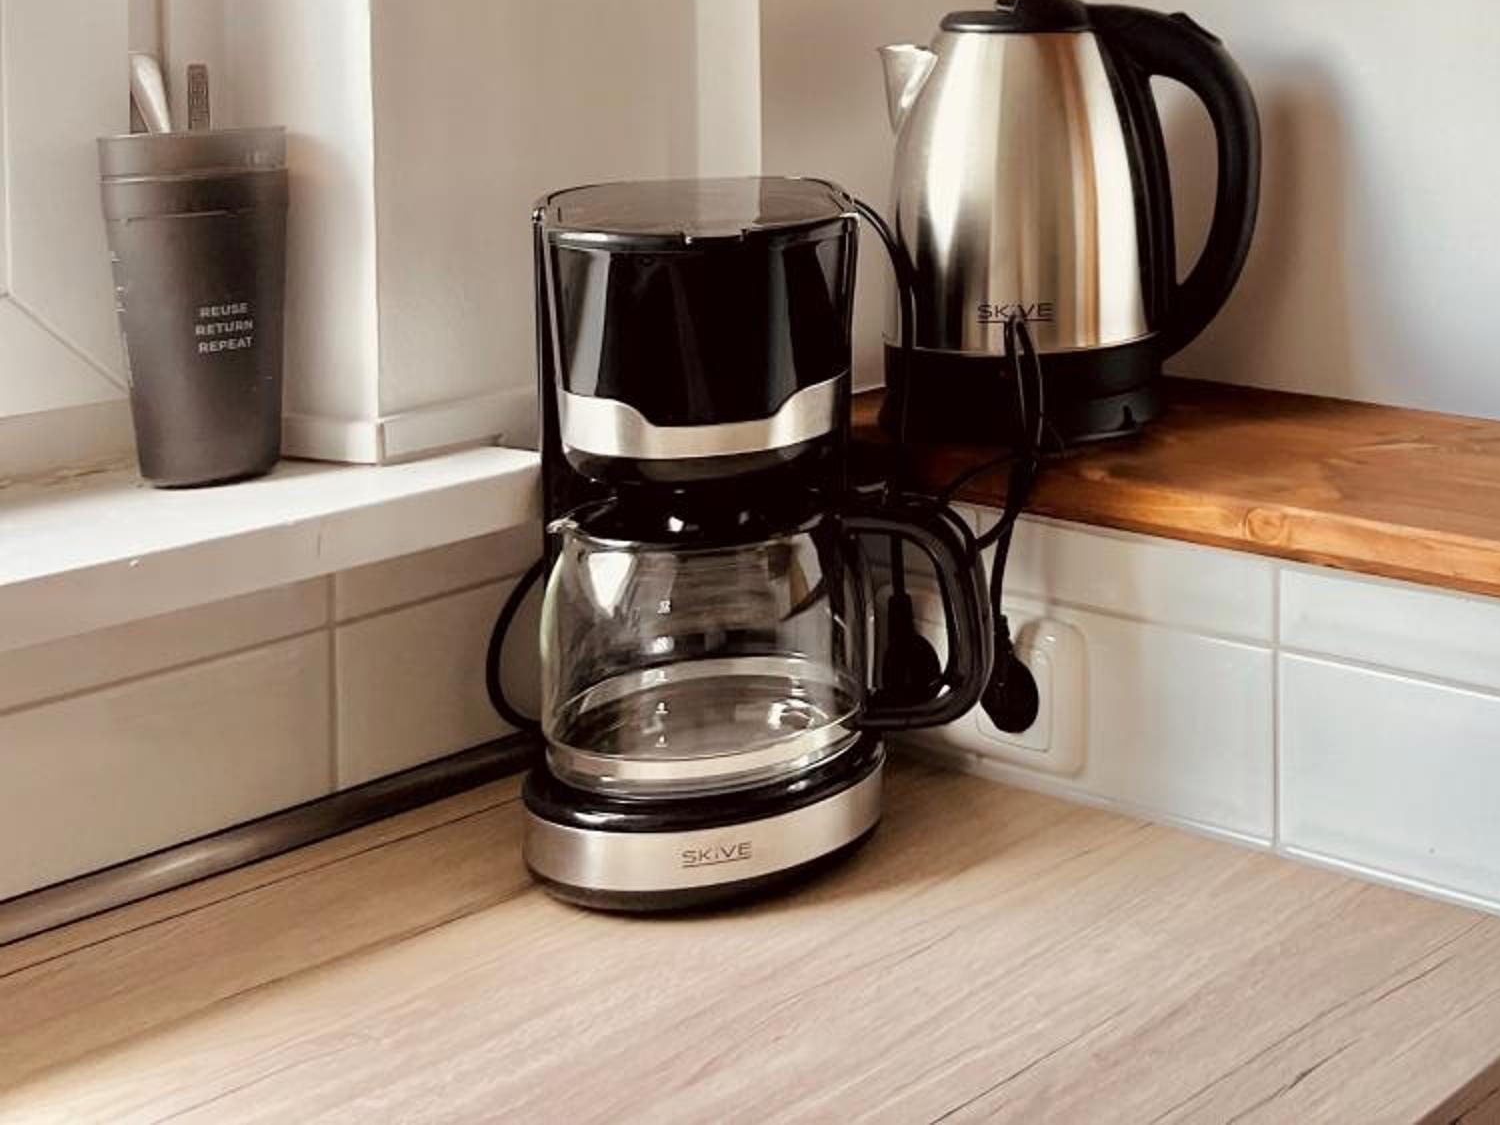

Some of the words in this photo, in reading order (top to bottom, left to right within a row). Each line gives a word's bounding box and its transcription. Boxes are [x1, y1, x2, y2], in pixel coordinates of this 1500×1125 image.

[199, 302, 249, 317] REUSE
[977, 301, 1054, 320] SKVE
[195, 320, 253, 335] RETURN
[198, 336, 252, 354] REPEAT
